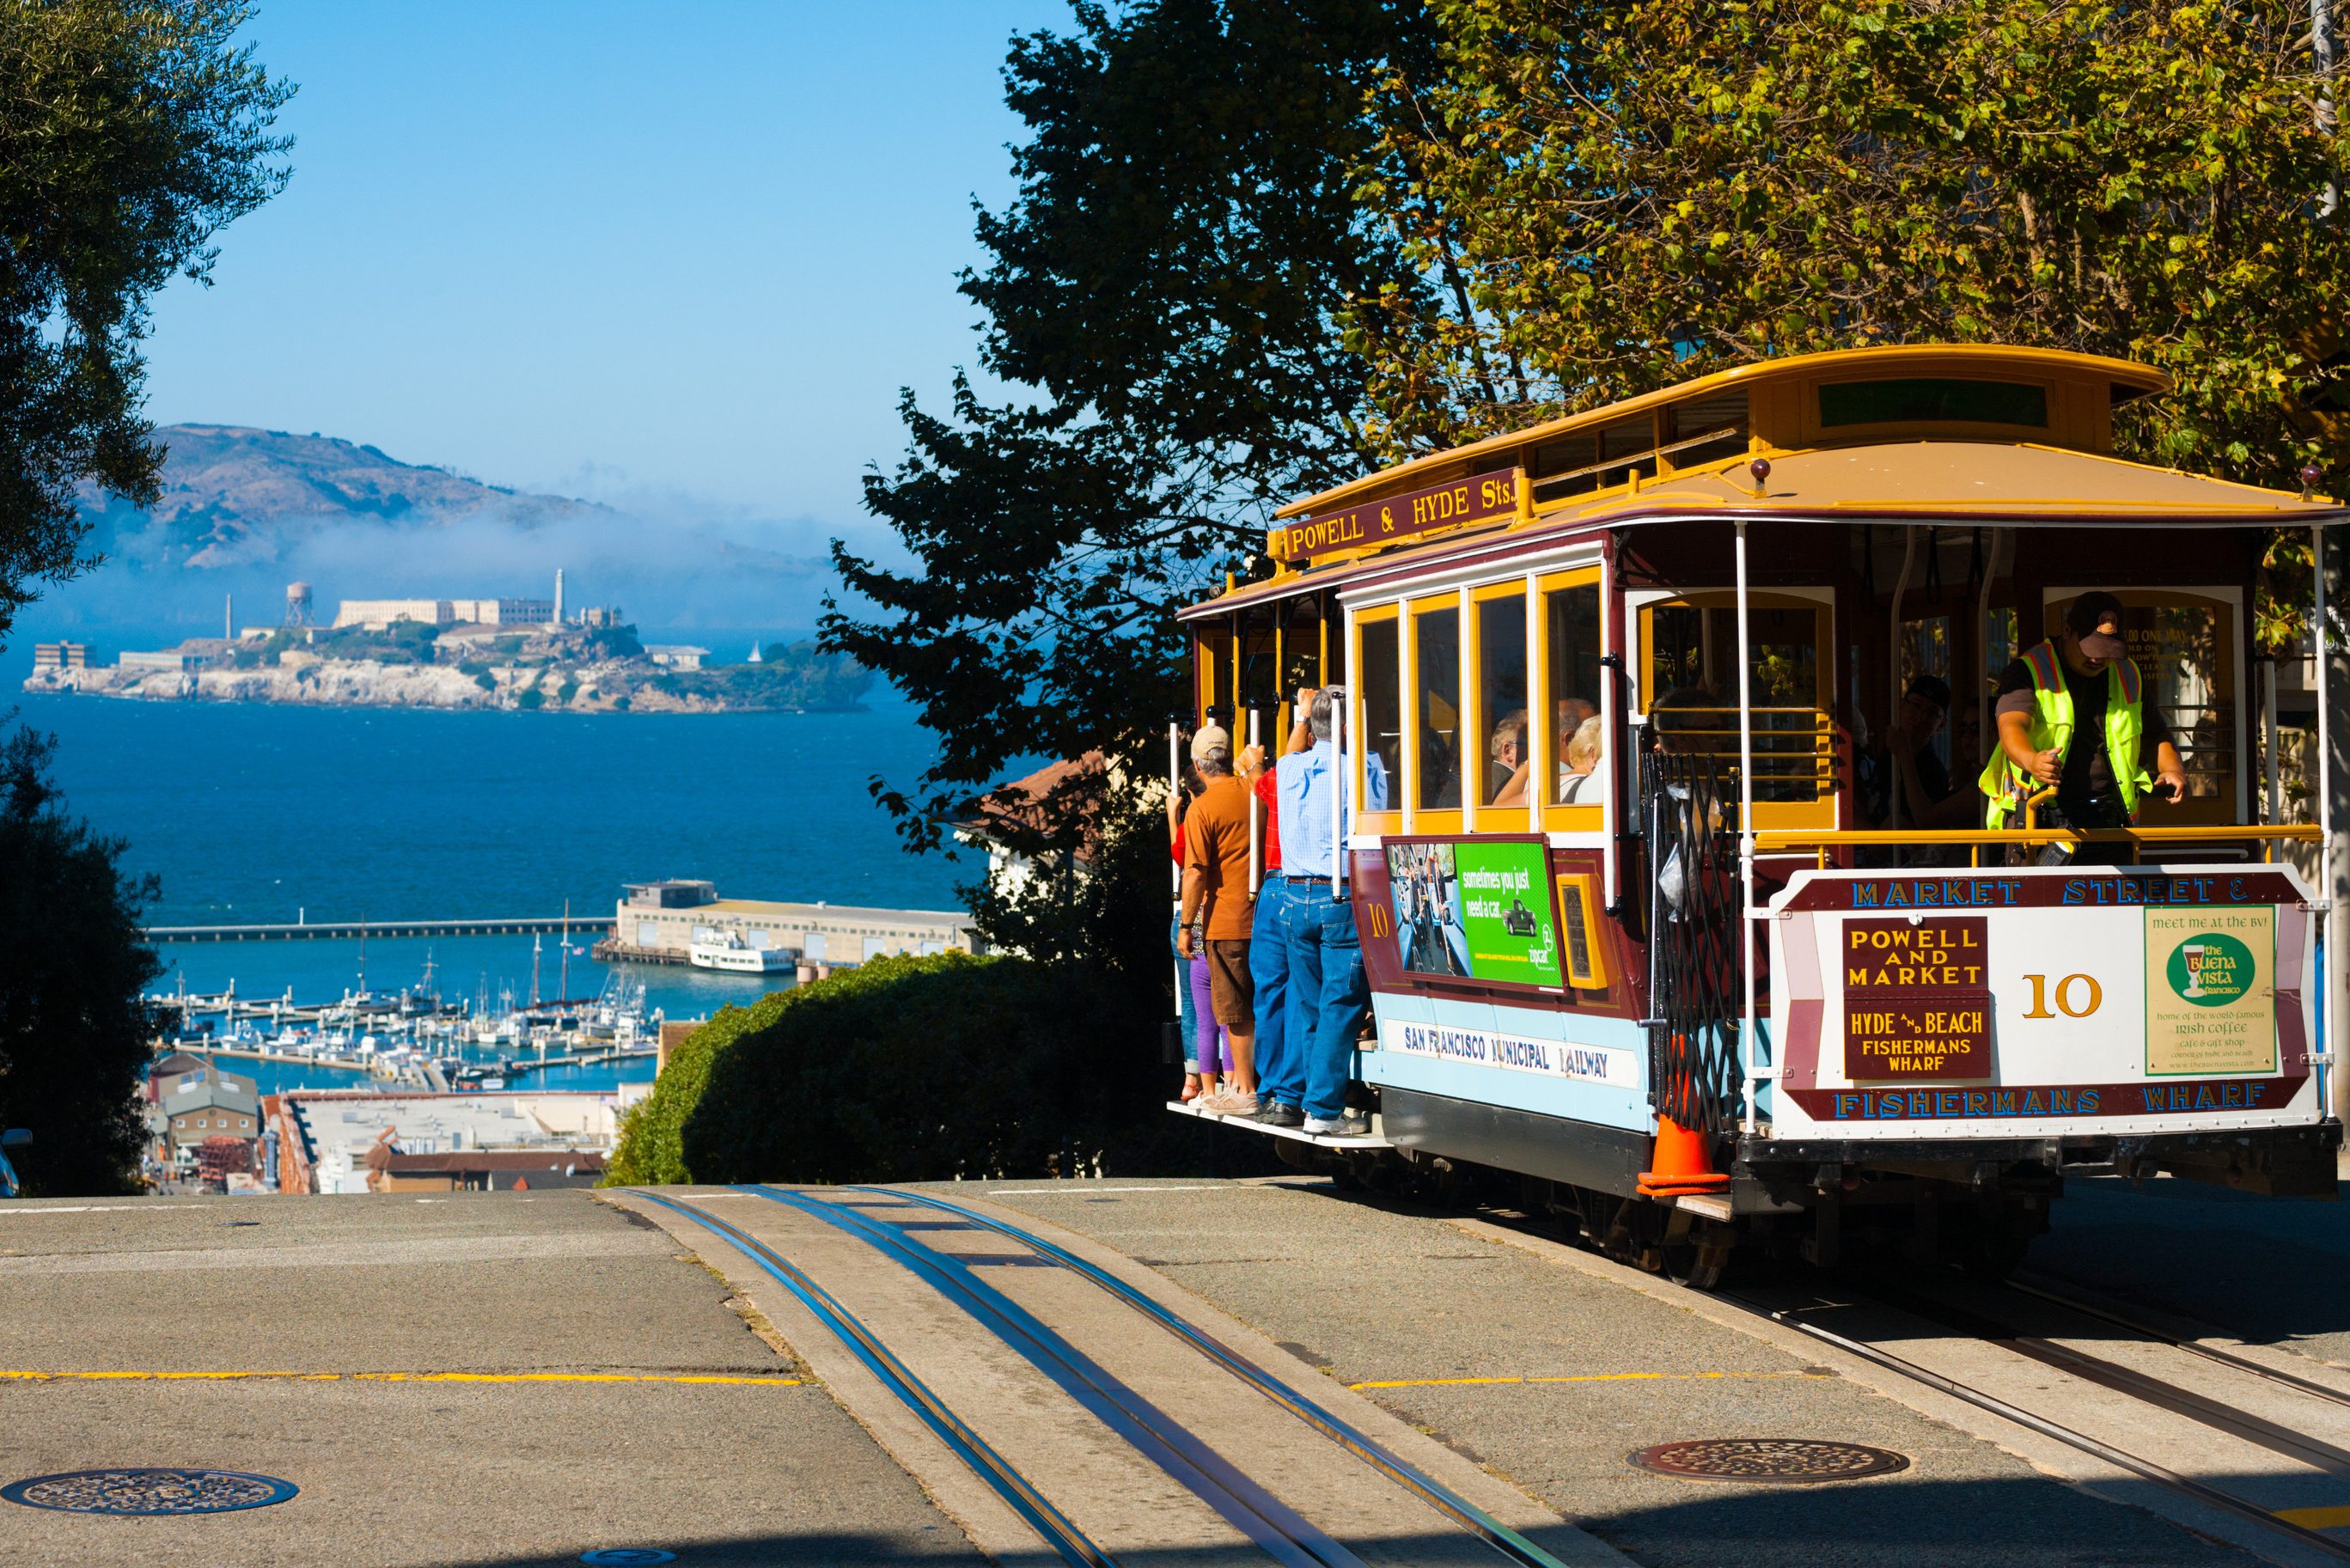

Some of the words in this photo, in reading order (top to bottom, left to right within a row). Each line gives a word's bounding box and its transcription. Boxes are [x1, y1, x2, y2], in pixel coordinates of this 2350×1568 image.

[1292, 514, 1364, 552] POWELL
[1381, 506, 1395, 533] &
[1413, 485, 1469, 525] HYDE
[1481, 479, 1517, 509] Sts.
[1462, 866, 1500, 888] sometimes
[1500, 872, 1514, 895] you
[1513, 866, 1530, 895] just
[1853, 880, 2021, 907] MARKET
[2063, 877, 2213, 905] STREET
[1466, 895, 1484, 918] need
[1483, 902, 1488, 917] a
[1488, 901, 1502, 918] car.
[1368, 903, 1389, 937] 10
[2152, 918, 2184, 929] meet
[2188, 919, 2207, 928] me
[2210, 917, 2223, 928] at
[2227, 916, 2247, 928] the
[2250, 918, 2268, 928] BV!
[1850, 930, 1978, 949] POWELL
[2205, 945, 2222, 955] the
[1529, 944, 1548, 967] zipcar
[1884, 950, 1948, 965] AND
[1849, 967, 1981, 985] MARKET
[2022, 973, 2103, 1018] 10
[1851, 1013, 1895, 1034] HYDE
[1900, 1013, 1921, 1034] AND
[1925, 1011, 1982, 1034] BEACH
[1405, 1027, 1425, 1051] SAN
[1428, 1030, 1486, 1060] FRANCISCO
[1862, 1039, 1971, 1055] FISHERMANS
[1889, 1056, 1944, 1071] WHARF
[1835, 1089, 2101, 1118] FISHERMANS
[2142, 1082, 2266, 1111] WHARF
